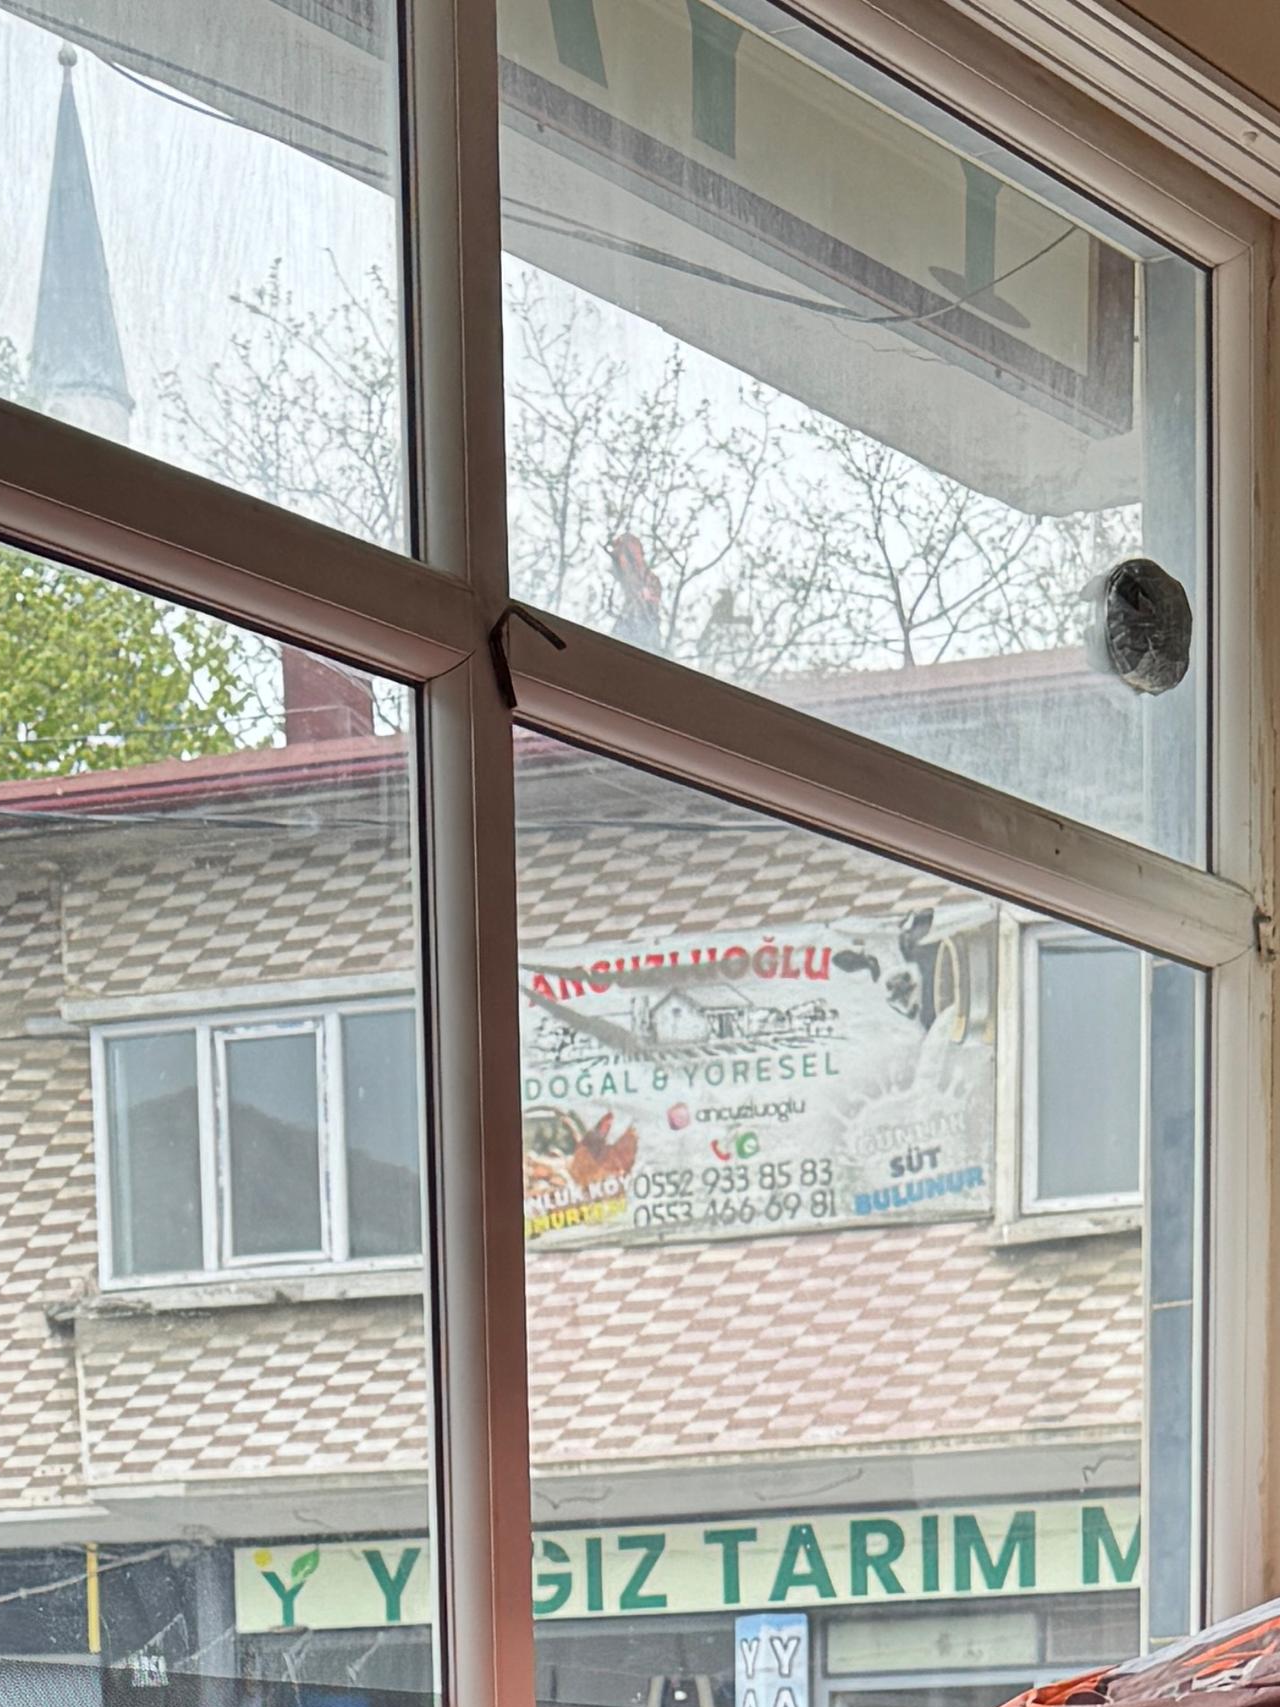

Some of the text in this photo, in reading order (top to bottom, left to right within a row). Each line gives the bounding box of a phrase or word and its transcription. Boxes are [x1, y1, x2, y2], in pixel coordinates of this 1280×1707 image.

[702, 1166, 750, 1192] 933
[759, 1160, 792, 1190] 85
[800, 1158, 833, 1187] 83
[889, 1145, 942, 1178] SÜT
[765, 1192, 802, 1221] 69
[810, 1189, 837, 1218] 81
[854, 1166, 986, 1216] BULUNUR
[703, 1510, 1037, 1606] TARIM
